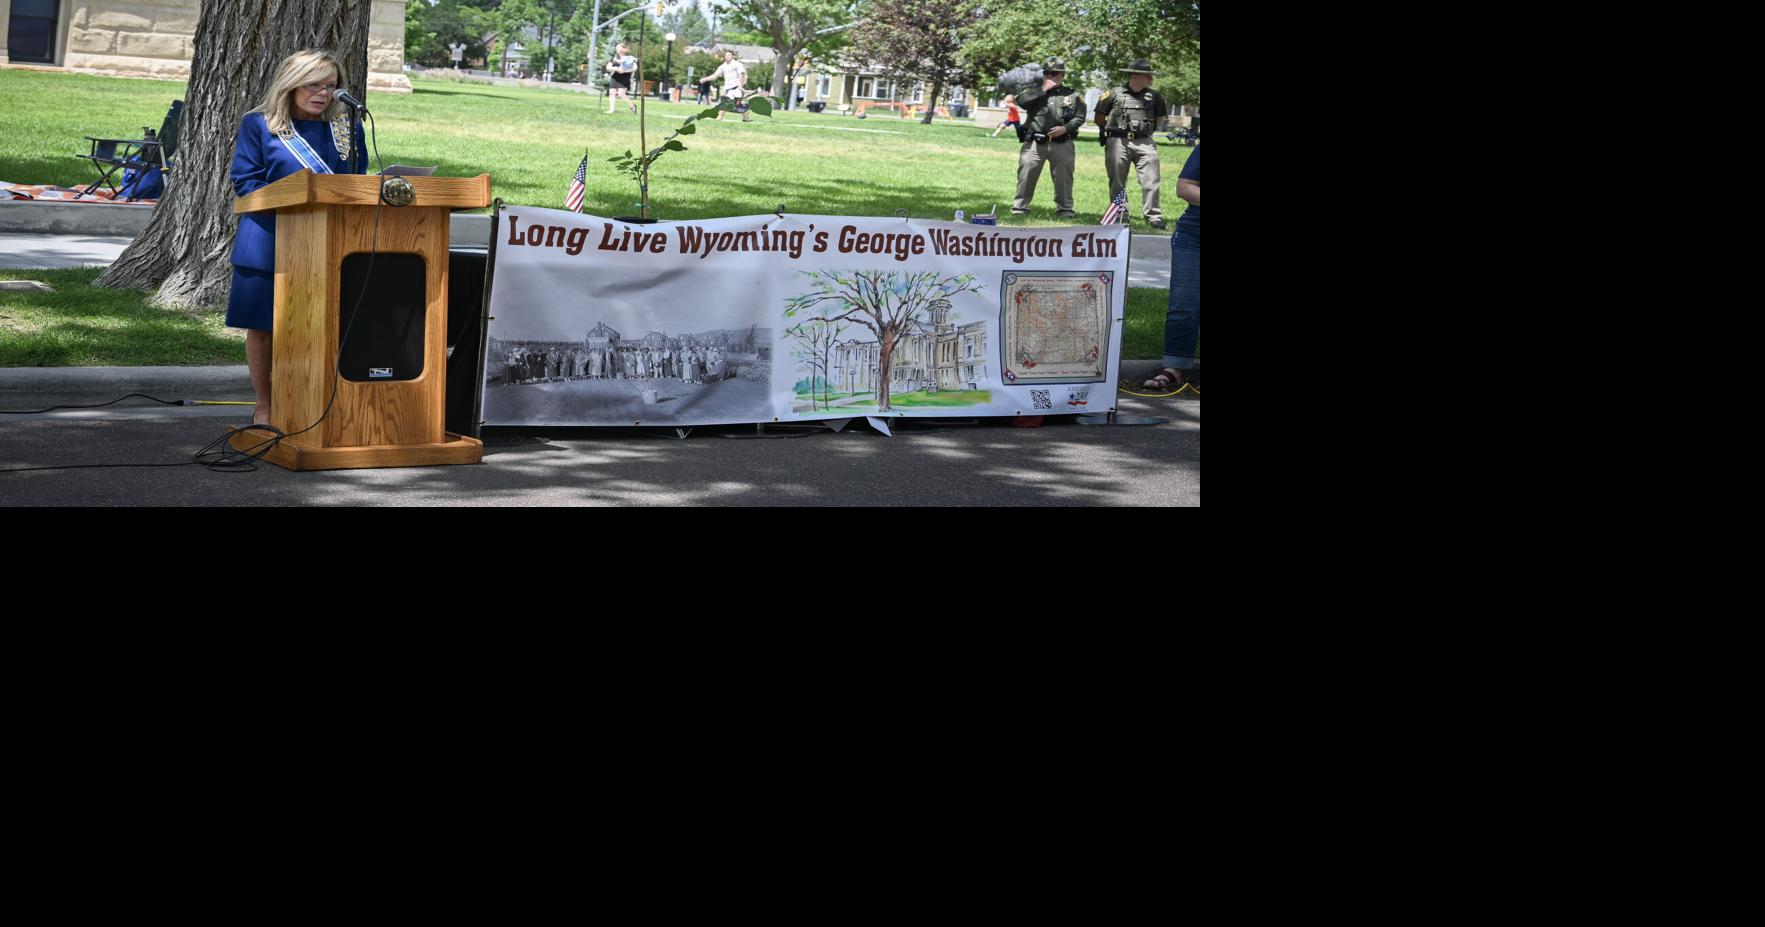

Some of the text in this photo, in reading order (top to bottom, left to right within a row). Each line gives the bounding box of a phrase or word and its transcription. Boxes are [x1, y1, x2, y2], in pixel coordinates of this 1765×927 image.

[508, 215, 1117, 263] Long Live Wyoming's George Washington Elm
